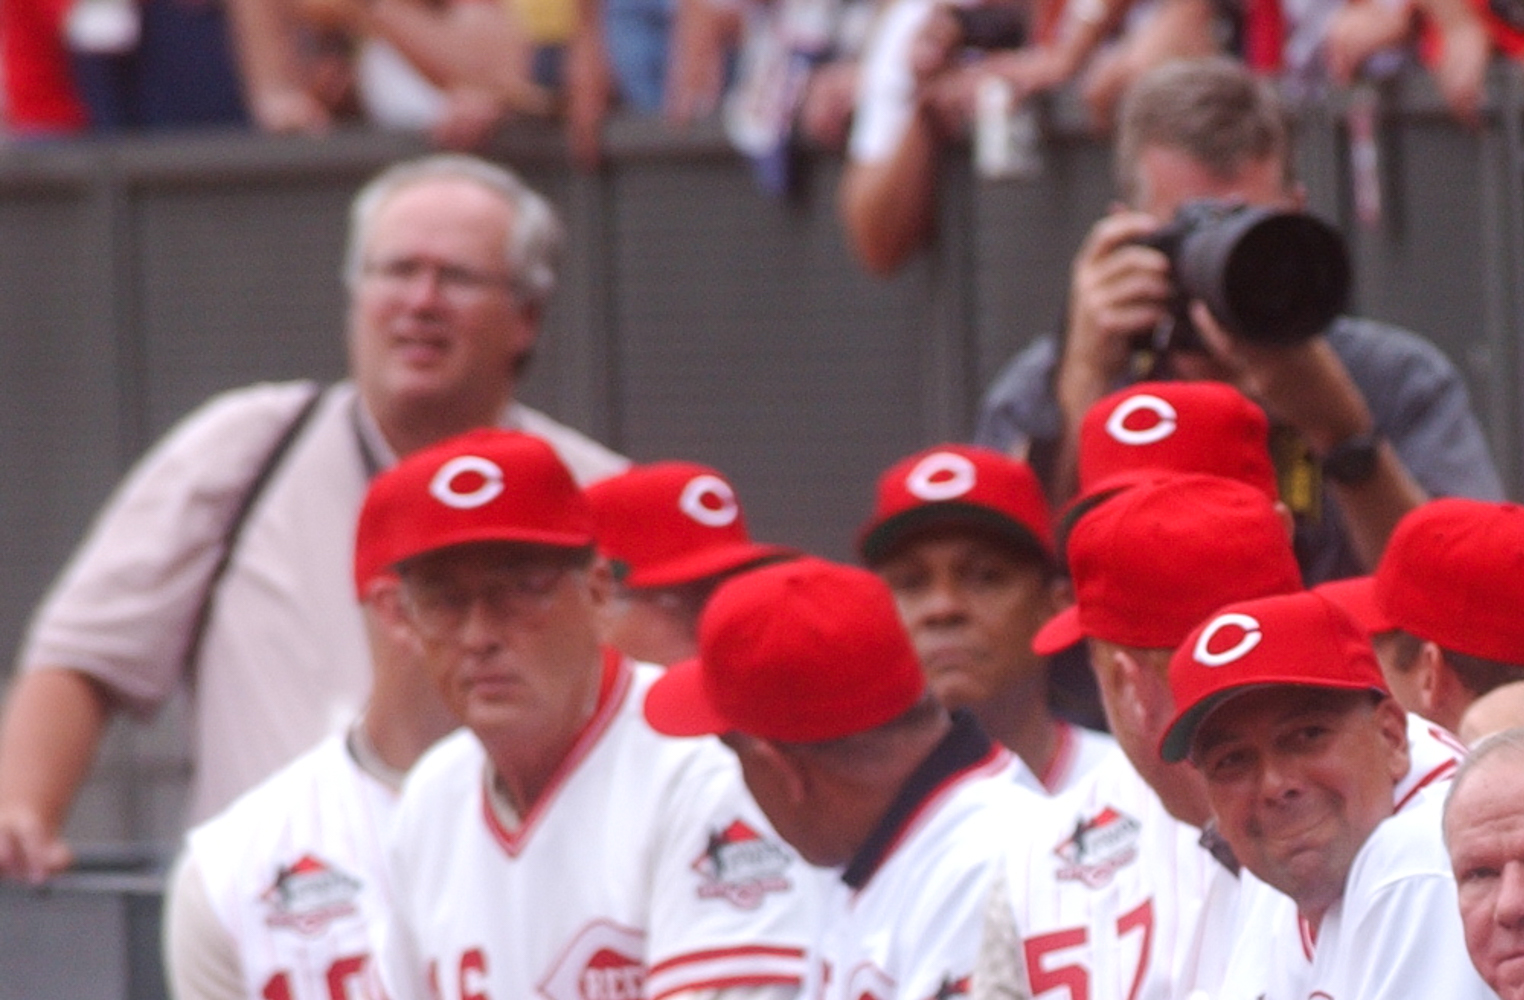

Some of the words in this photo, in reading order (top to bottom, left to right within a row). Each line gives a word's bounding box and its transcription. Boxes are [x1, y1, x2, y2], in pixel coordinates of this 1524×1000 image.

[1106, 395, 1177, 444] C
[429, 456, 505, 509] C
[1193, 614, 1262, 665] C
